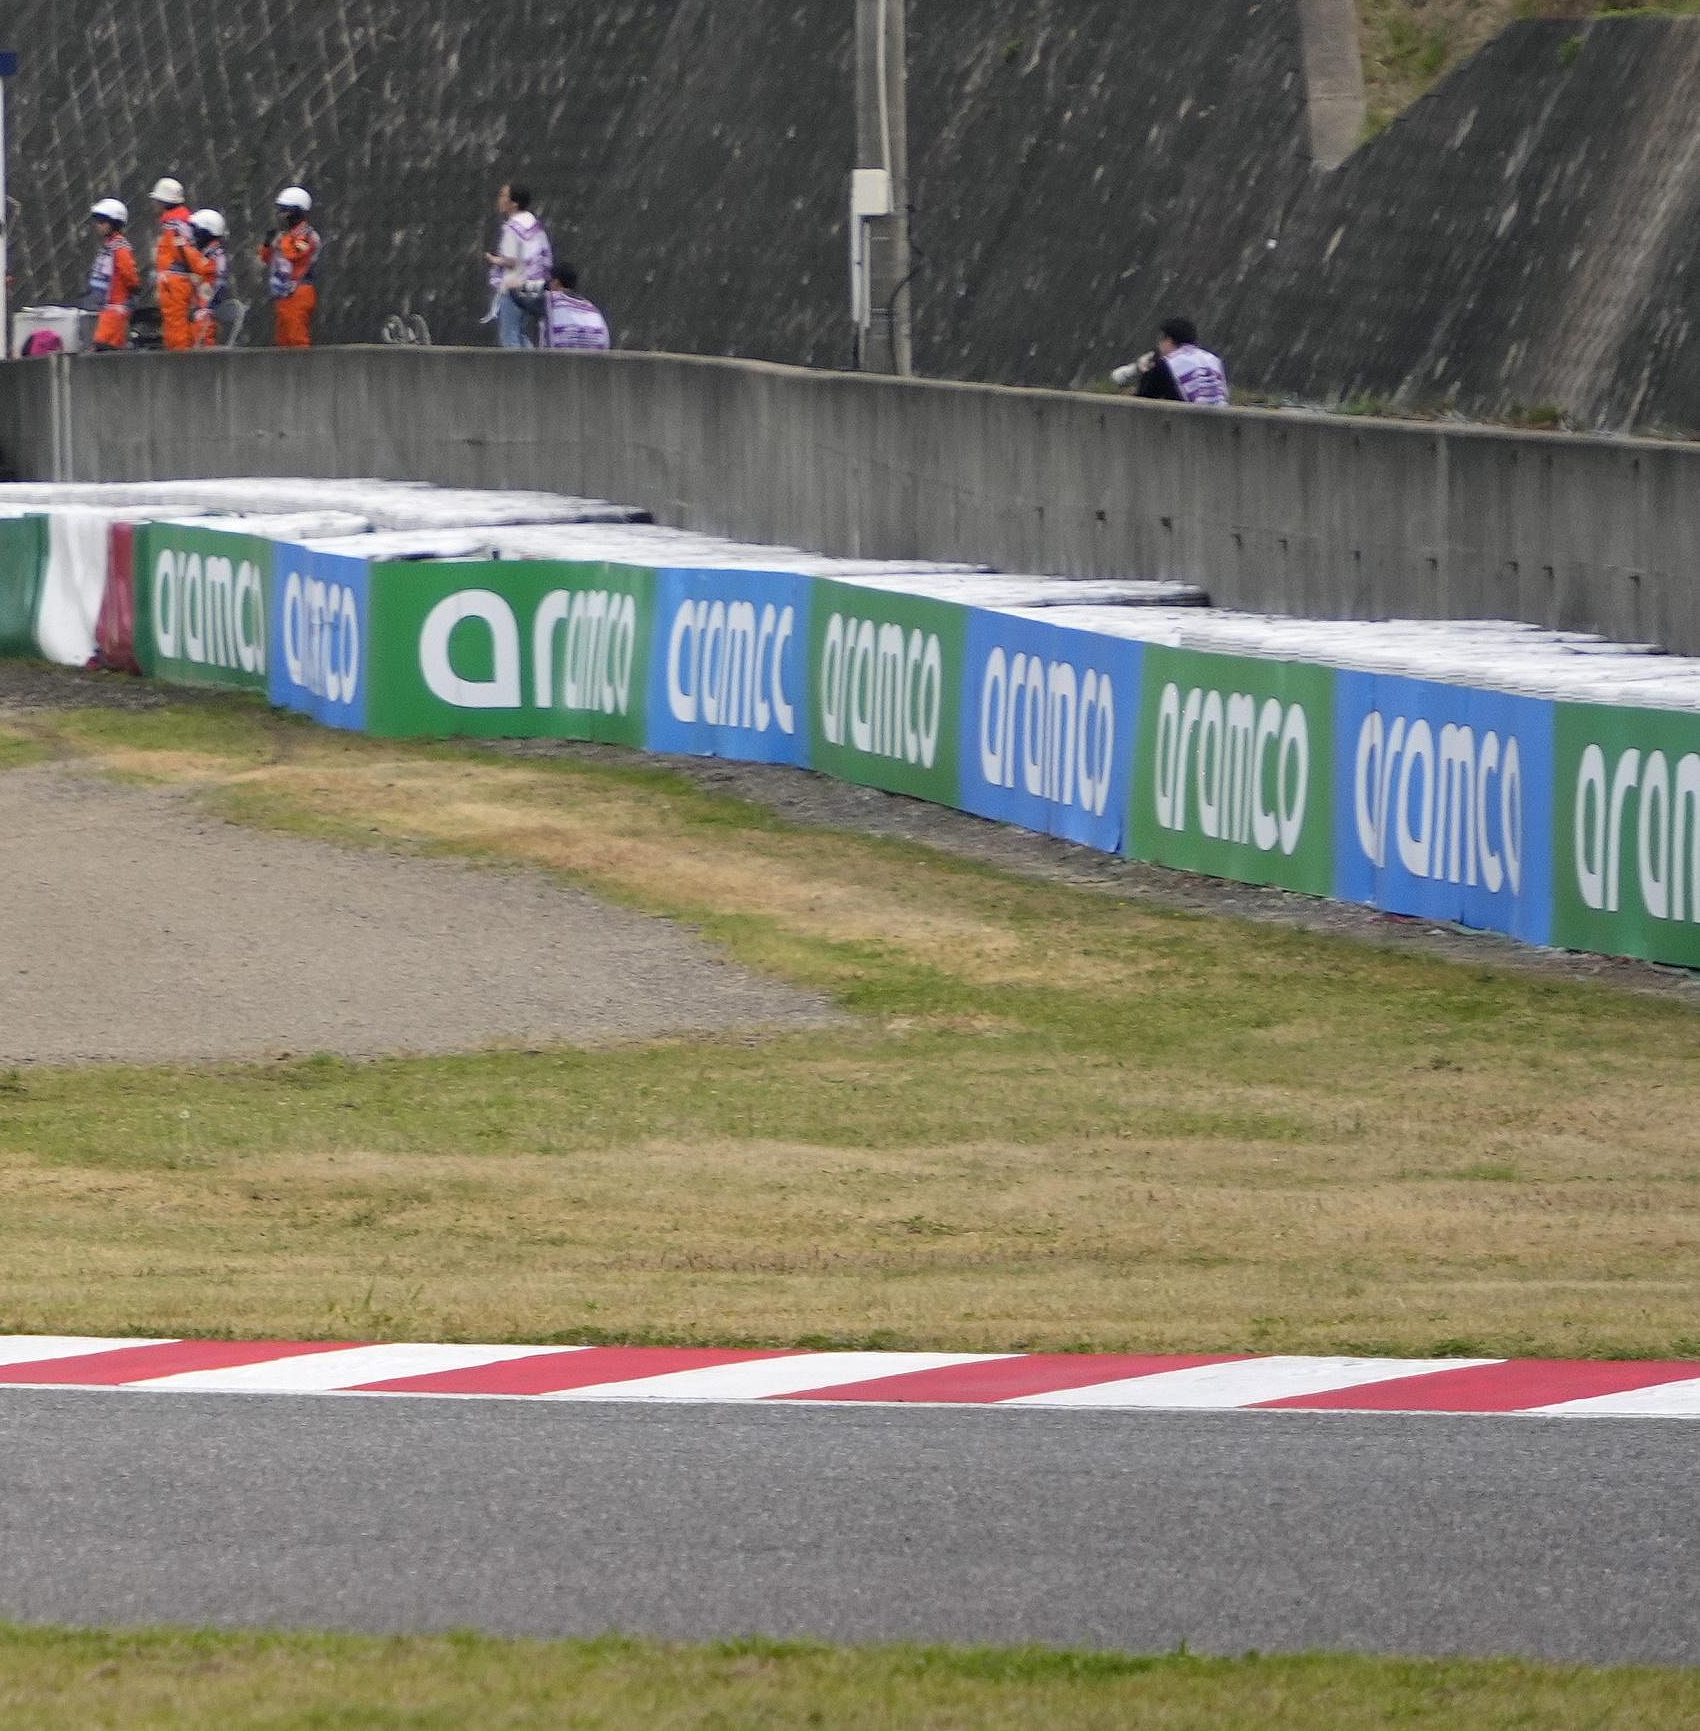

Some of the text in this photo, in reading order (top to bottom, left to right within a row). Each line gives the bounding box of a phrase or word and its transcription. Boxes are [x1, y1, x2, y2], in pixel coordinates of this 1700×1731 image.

[419, 588, 636, 715] aramco
[821, 612, 942, 769] aramco
[980, 646, 1114, 817] aramco
[1155, 681, 1310, 855] aramco
[1355, 710, 1521, 896] aramco
